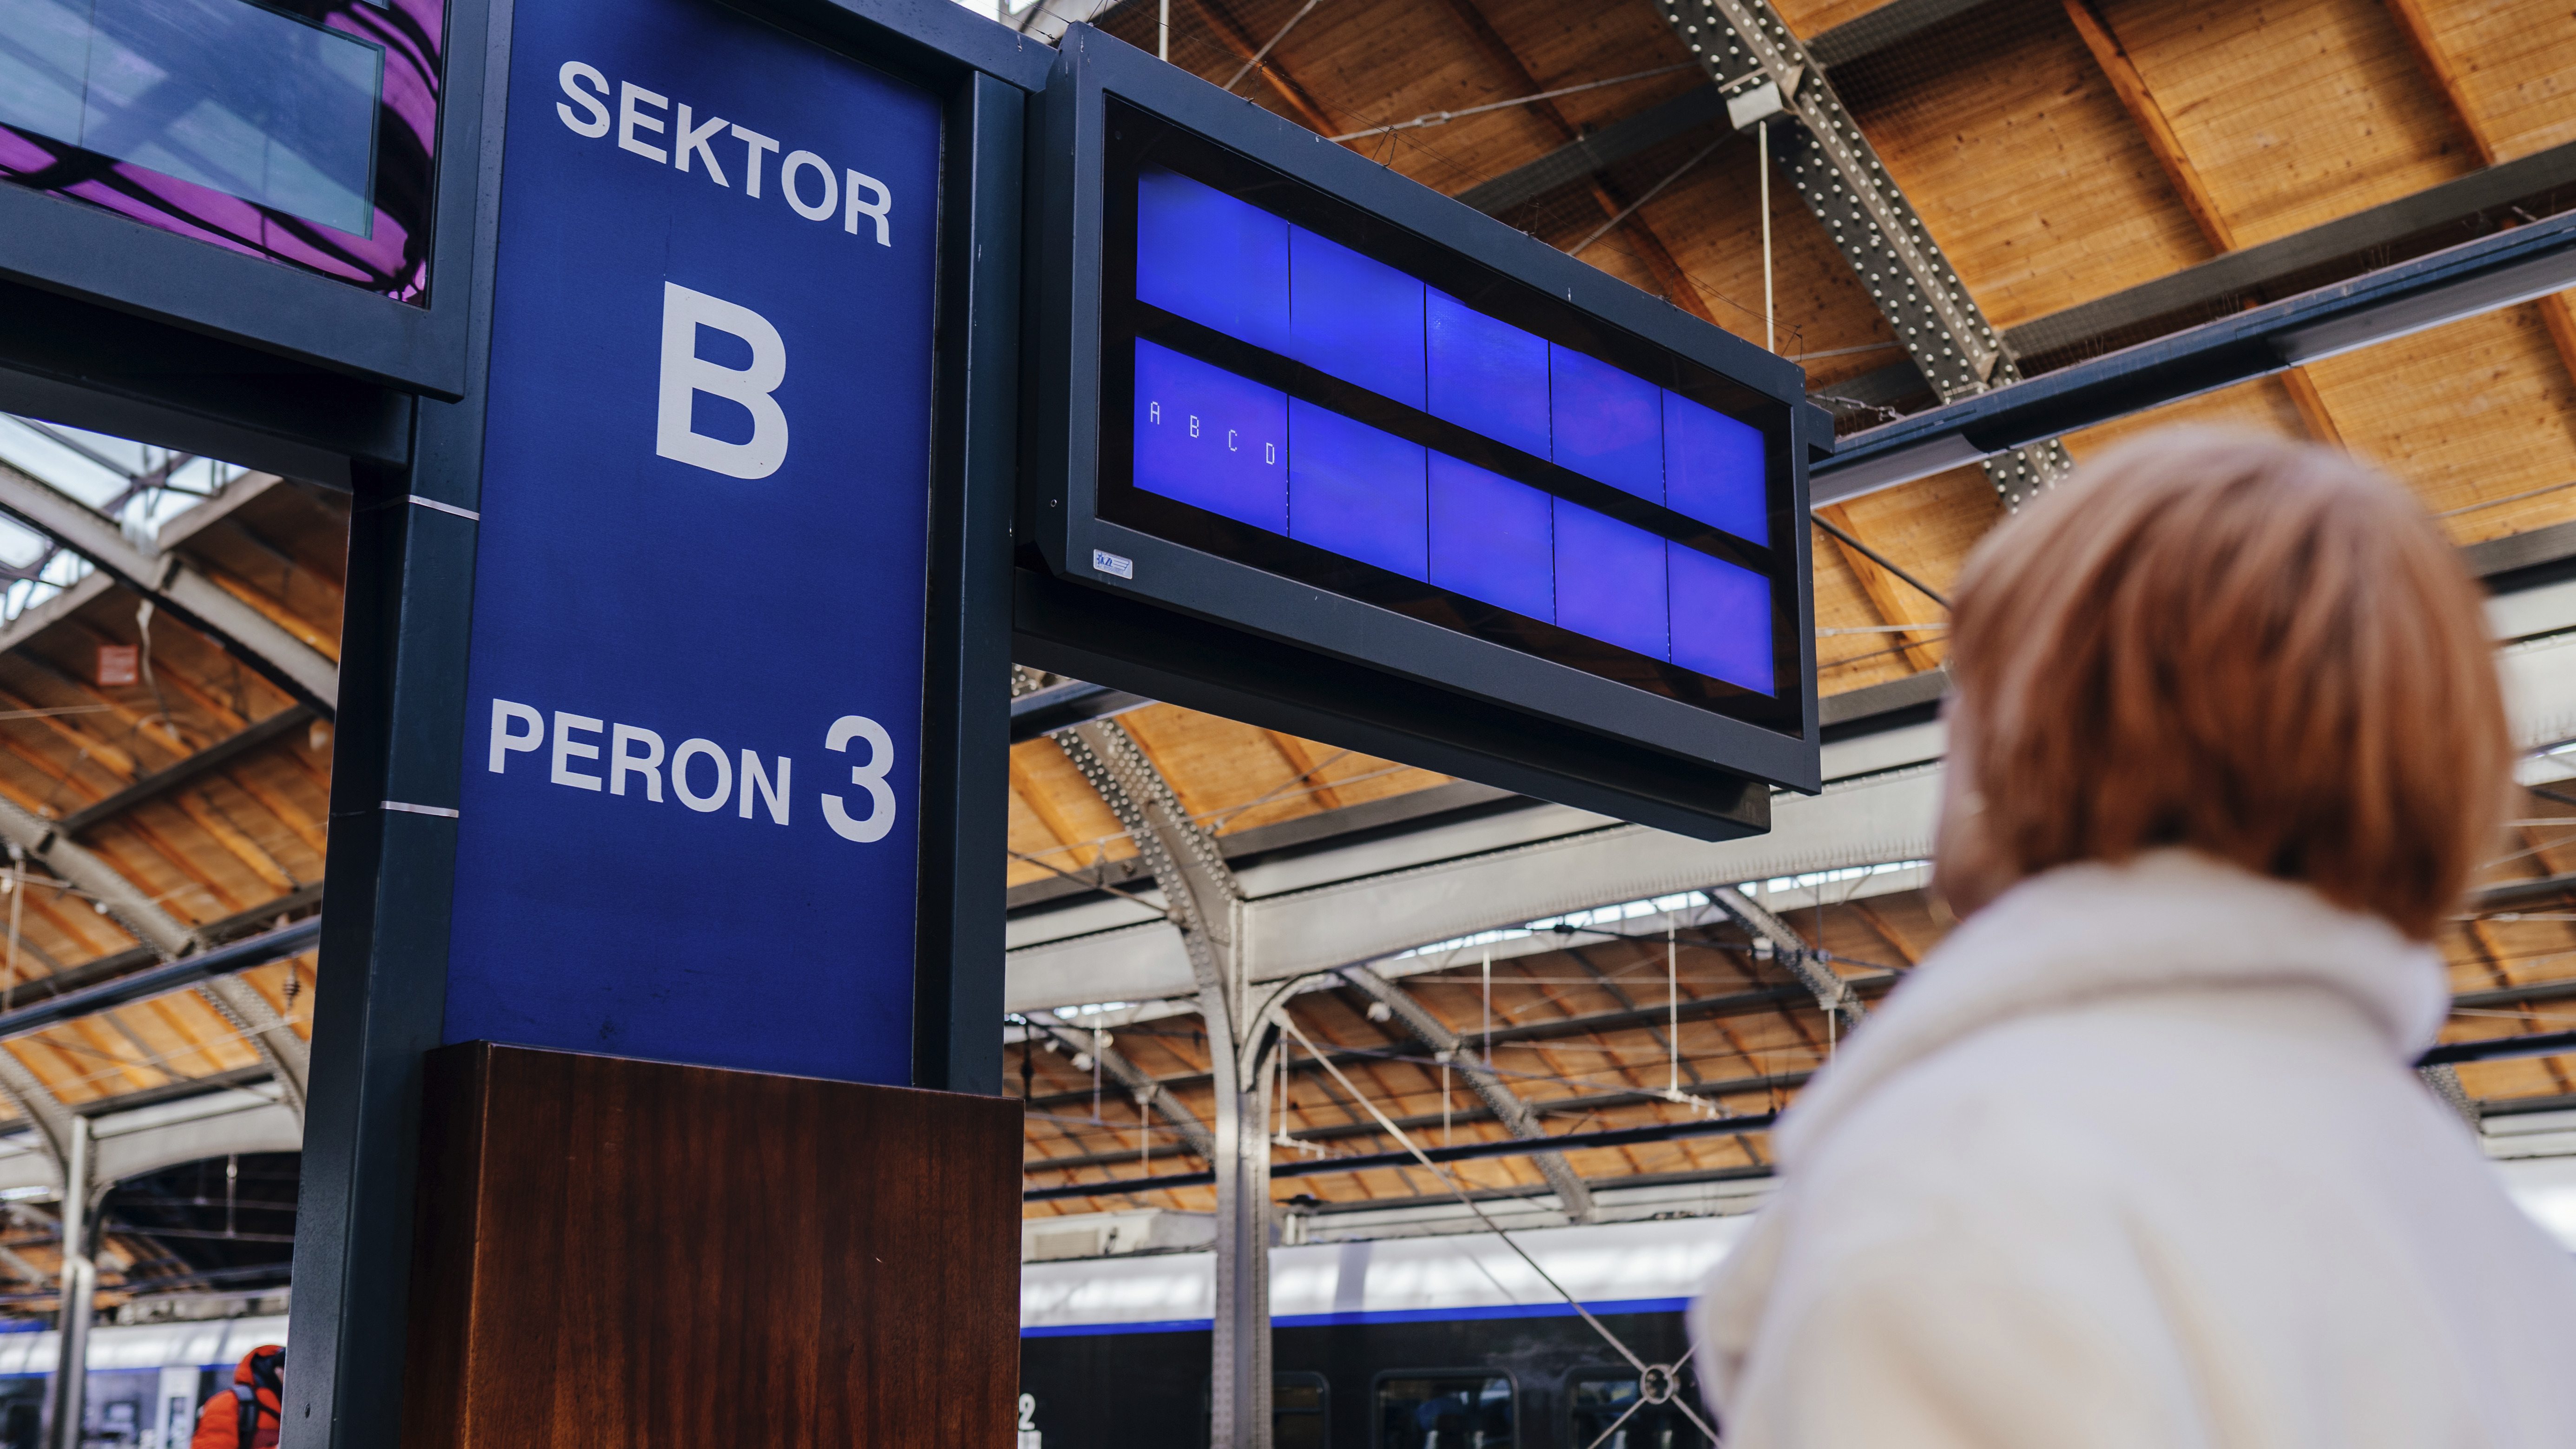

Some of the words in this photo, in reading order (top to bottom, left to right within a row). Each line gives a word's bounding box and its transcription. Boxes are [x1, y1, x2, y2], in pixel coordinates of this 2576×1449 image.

[556, 60, 892, 248] SEKTOR
[655, 280, 790, 481] B
[1150, 401, 1160, 425] A
[1190, 415, 1199, 438] B
[1228, 429, 1238, 452] C
[1266, 442, 1275, 465] D
[488, 698, 792, 826] PERON
[821, 715, 897, 843] 3
[1019, 1393, 1035, 1429] 2
